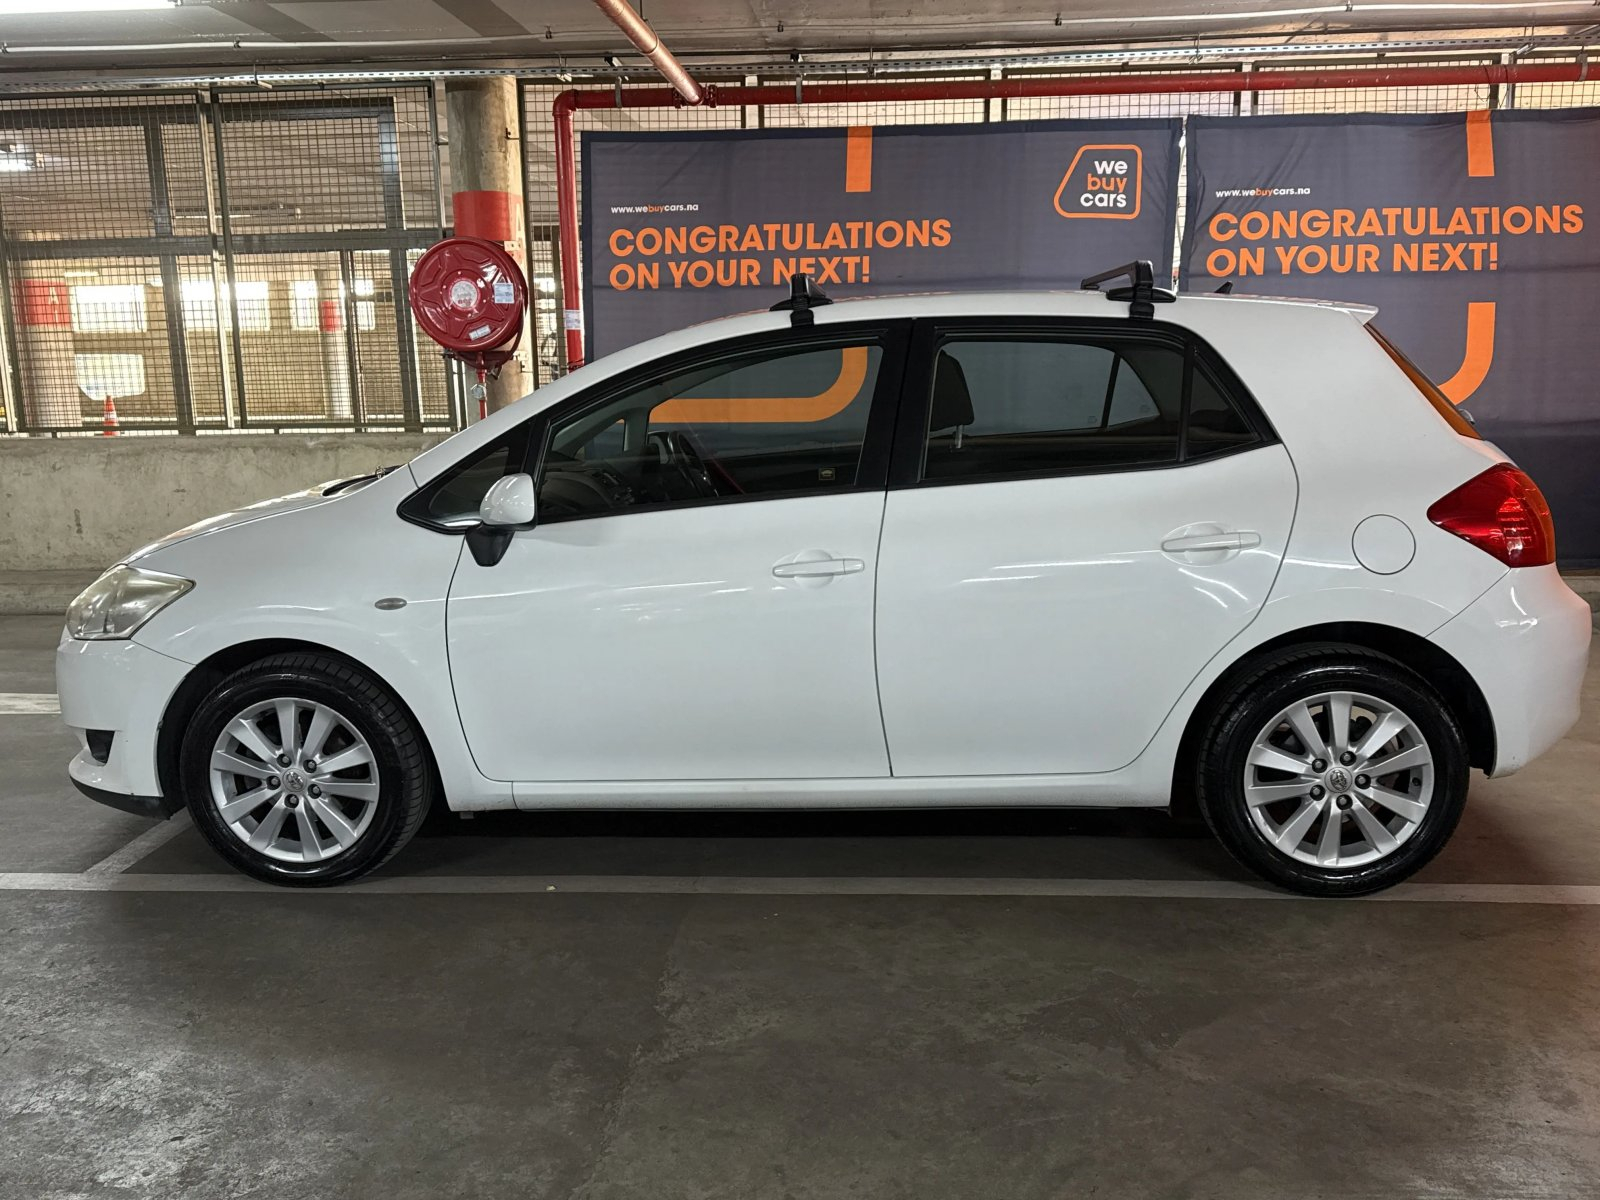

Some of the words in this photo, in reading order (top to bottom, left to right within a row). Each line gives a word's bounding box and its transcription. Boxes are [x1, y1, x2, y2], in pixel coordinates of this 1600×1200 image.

[1094, 160, 1128, 174] we
[1087, 173, 1127, 193] buy
[1215, 187, 1311, 198] www.webuycars.na
[610, 203, 699, 215] www.webuycars.na
[1080, 193, 1127, 207] cars
[1208, 204, 1584, 242] CONGRATULATIONS
[609, 218, 952, 257] CONGRATULATIONS
[1205, 246, 1265, 278] ON
[1275, 243, 1380, 275] YOUR
[1392, 241, 1498, 272] NEXT!
[609, 262, 660, 291] ON
[667, 258, 761, 289] YOUR
[773, 255, 870, 285] NEXT!
